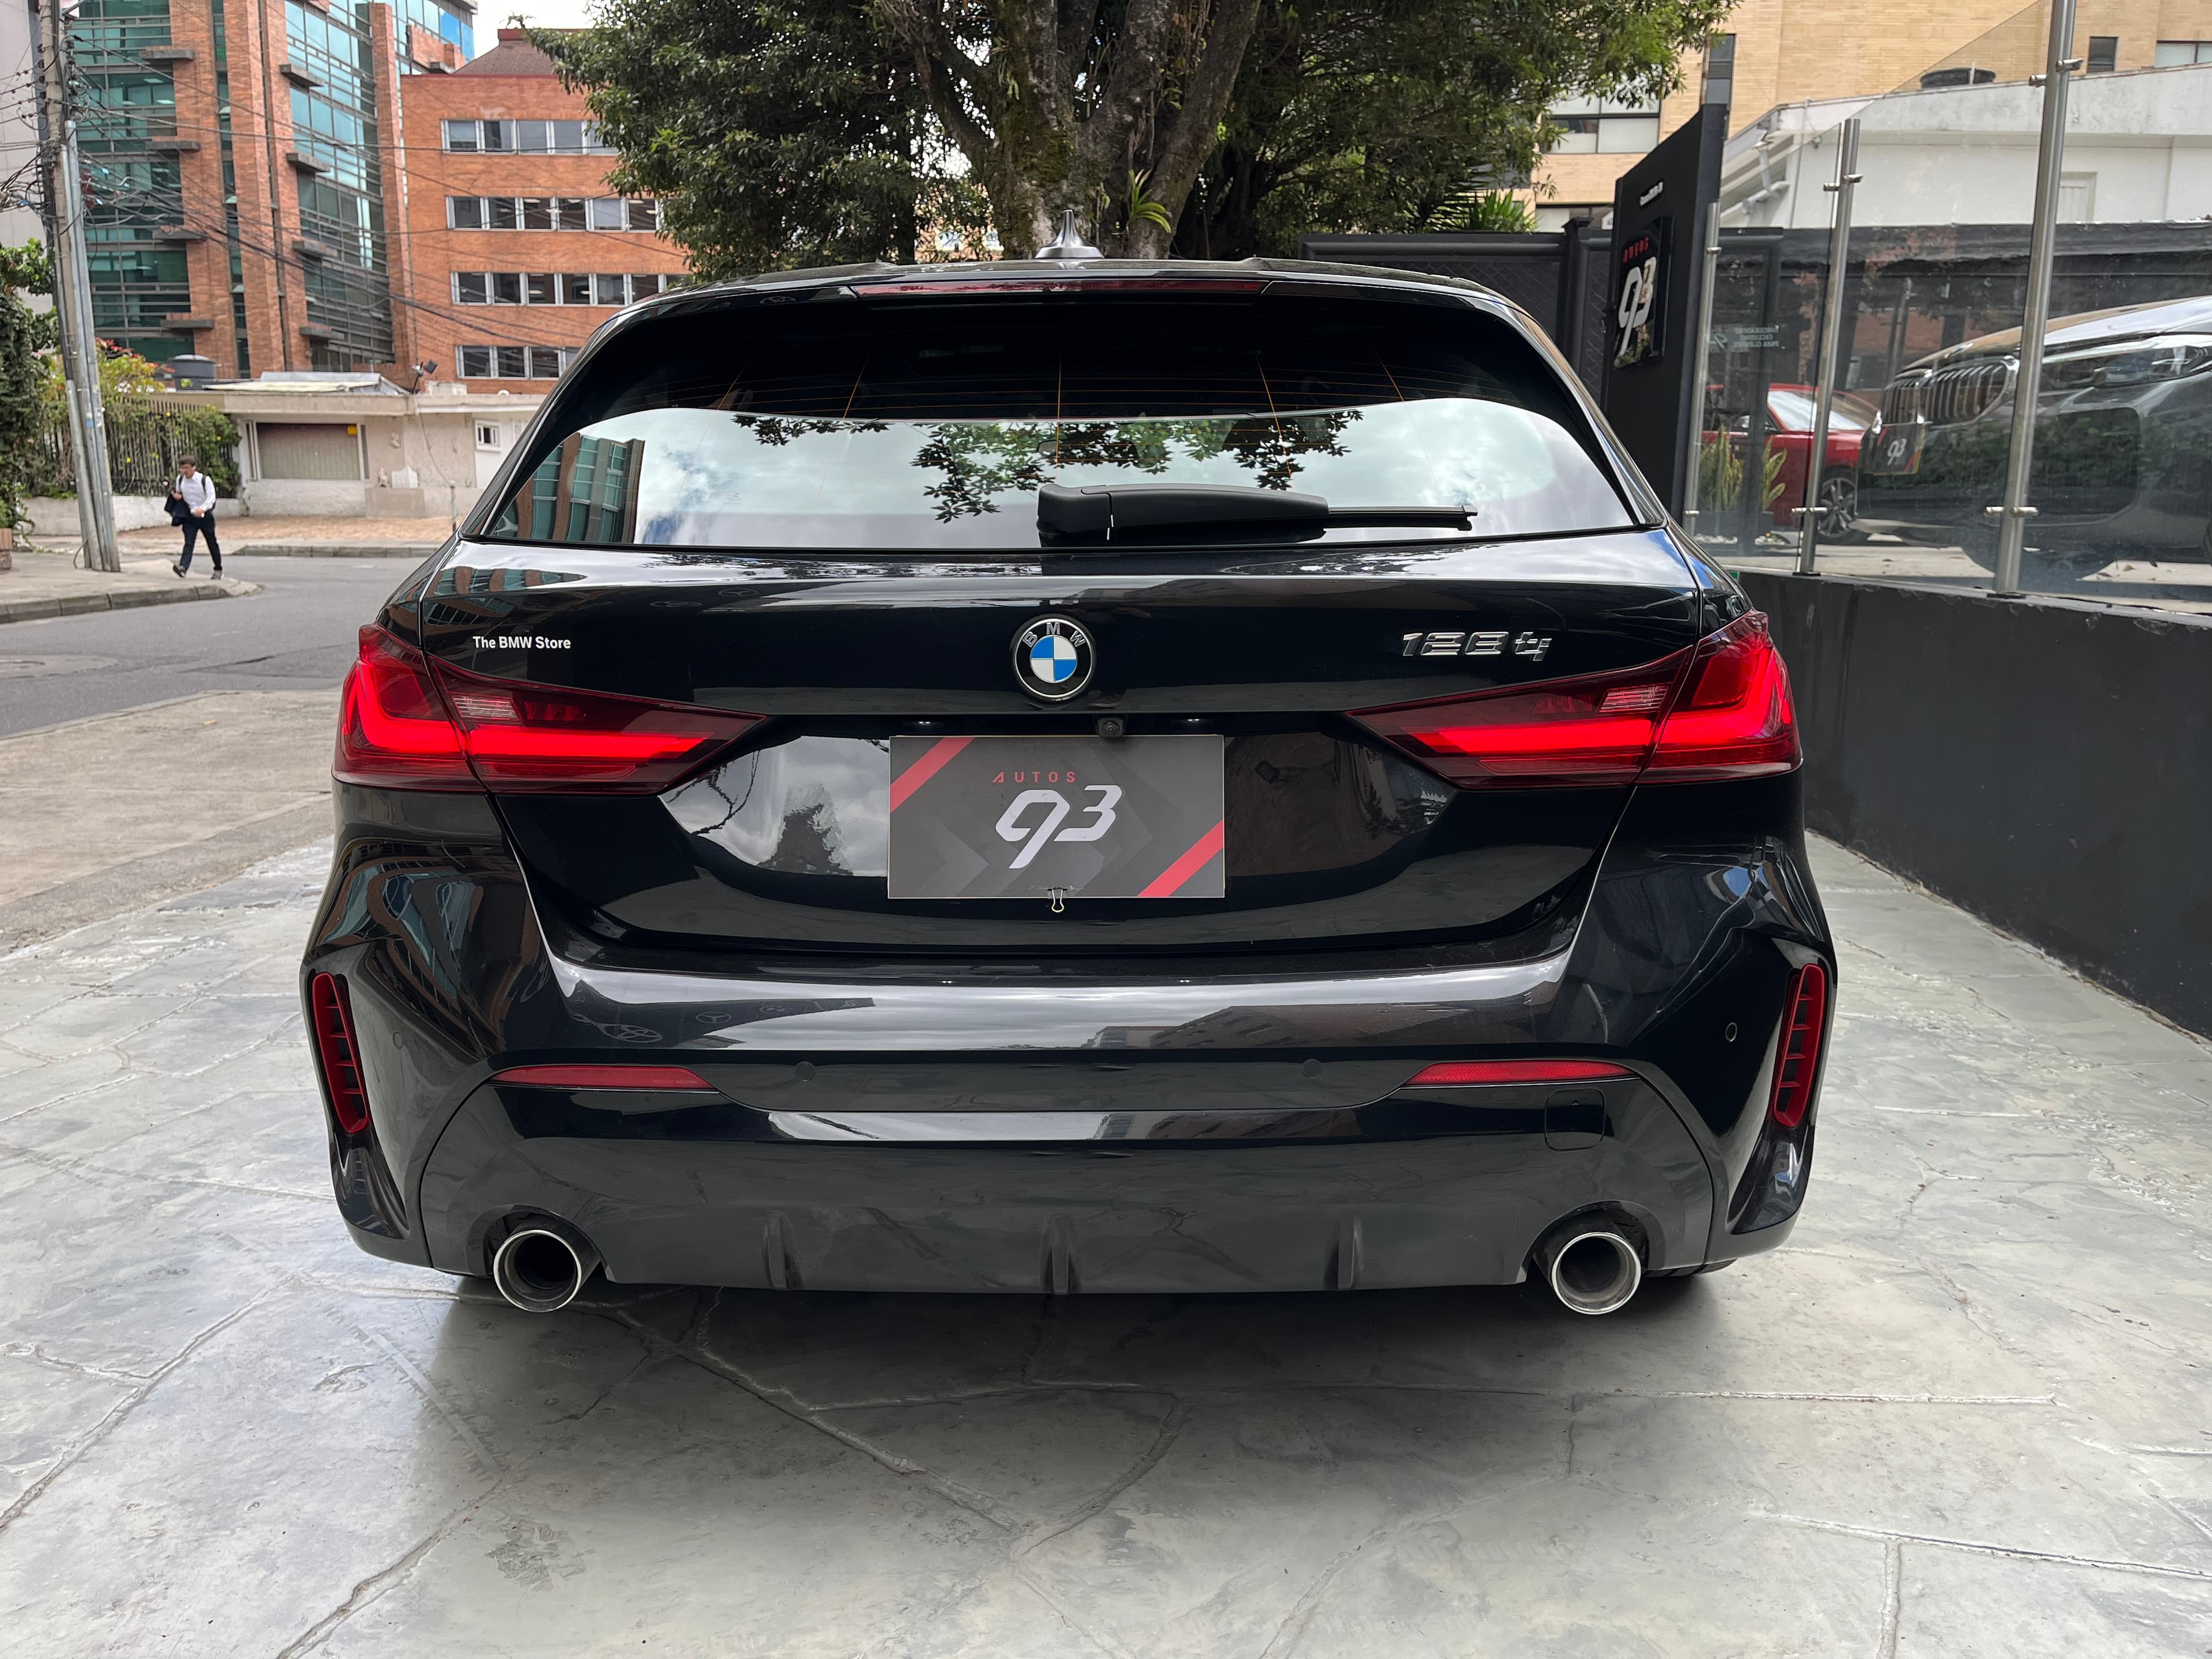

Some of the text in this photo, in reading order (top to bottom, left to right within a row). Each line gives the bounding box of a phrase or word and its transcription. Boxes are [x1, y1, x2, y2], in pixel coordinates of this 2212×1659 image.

[1622, 236, 1649, 263] AUTOS
[472, 636, 571, 649] The BMW Store
[1022, 622, 1086, 648] BMW
[992, 771, 1076, 783] AUTOS
[995, 784, 1123, 869] 93
